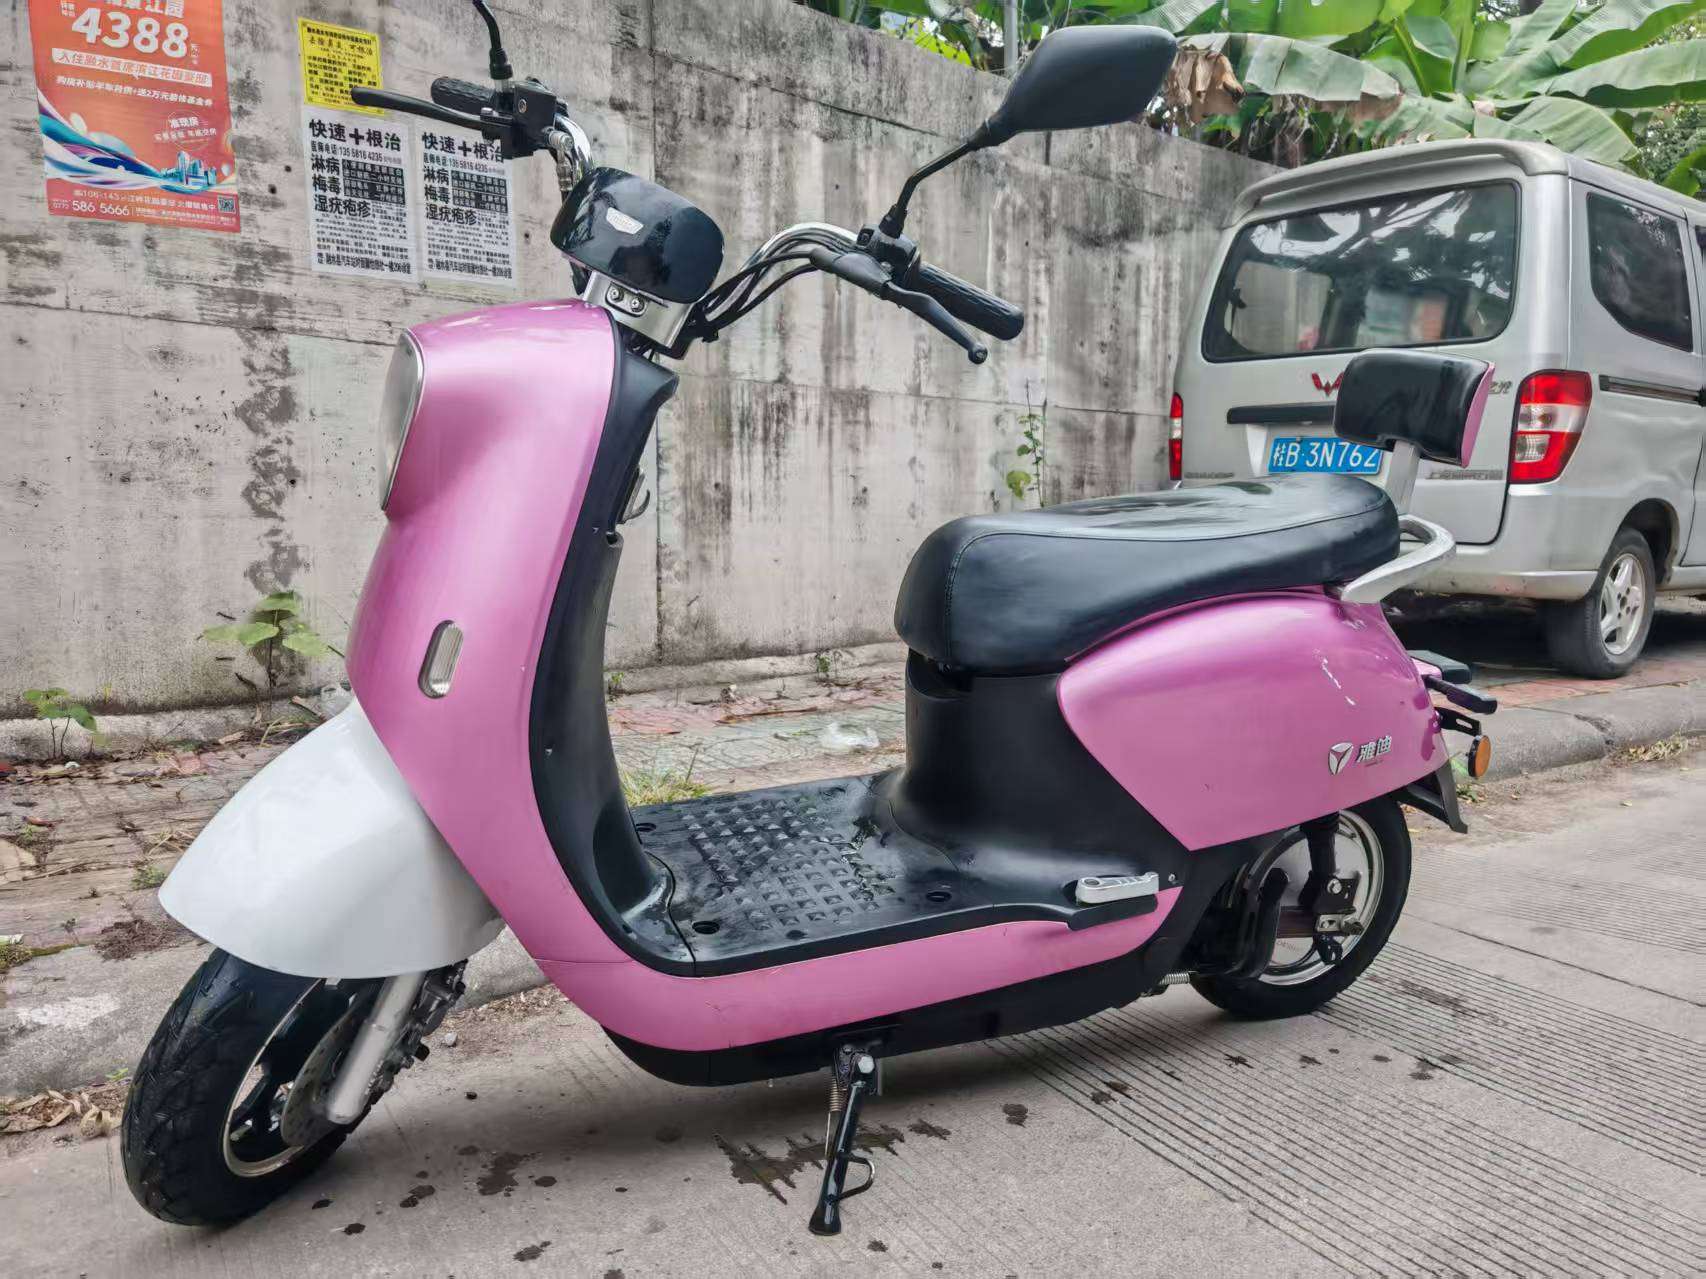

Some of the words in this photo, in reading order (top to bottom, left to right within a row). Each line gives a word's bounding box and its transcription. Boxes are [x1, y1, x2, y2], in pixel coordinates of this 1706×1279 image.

[72, 7, 190, 58] 4388
[310, 153, 340, 176] 淋病
[423, 164, 450, 186] 淋病
[312, 173, 342, 196] 梅毒
[424, 183, 450, 204] 梅毒
[71, 200, 96, 213] 586
[99, 203, 130, 216] 5666
[1356, 735, 1393, 762] 雅迪
